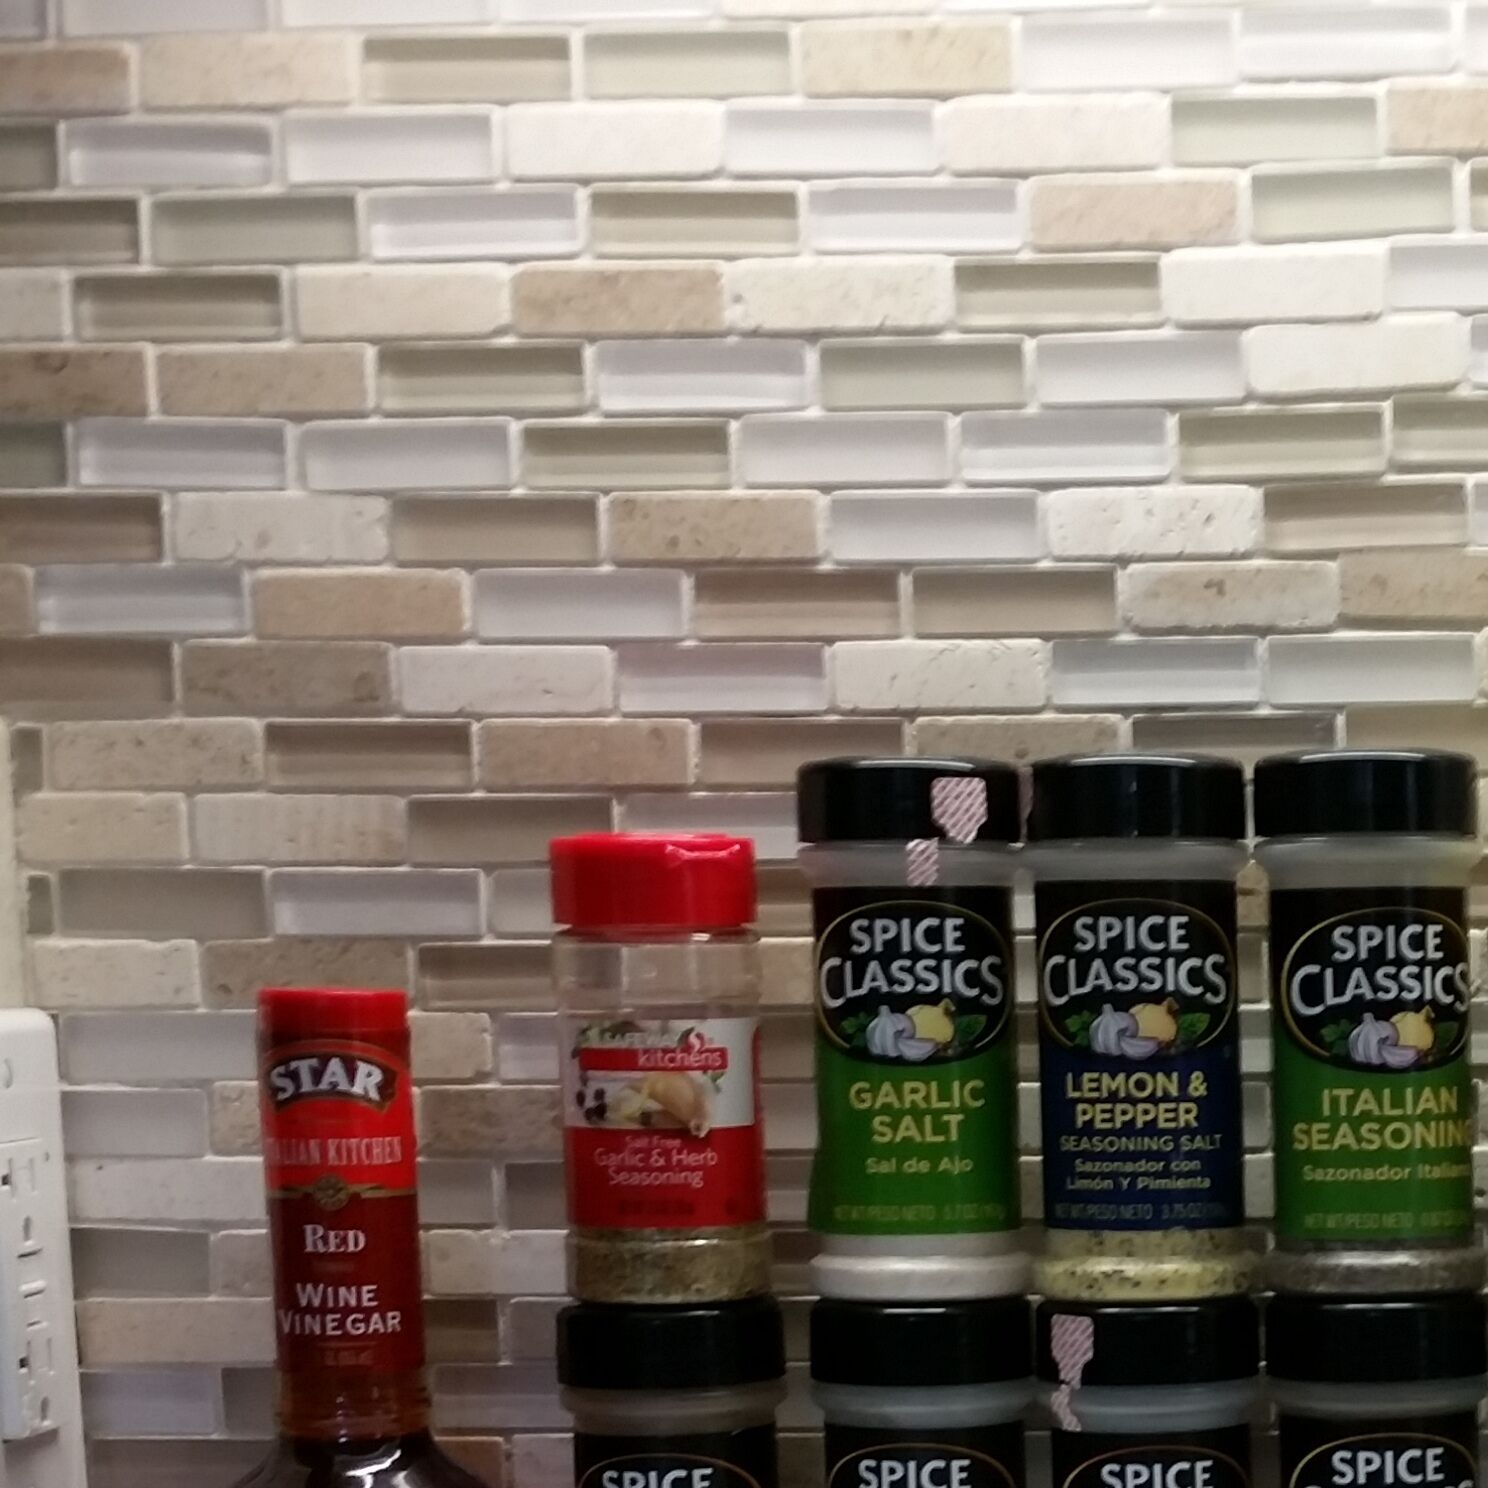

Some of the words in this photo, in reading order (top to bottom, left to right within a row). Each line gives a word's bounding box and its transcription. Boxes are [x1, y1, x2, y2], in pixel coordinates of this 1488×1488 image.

[850, 917, 966, 955] SPICE
[1073, 915, 1191, 952] SPICE
[1331, 924, 1444, 961] SPICE
[820, 955, 1004, 1009] CLASSICS
[1043, 953, 1227, 1007] CLASSICS
[1290, 962, 1469, 1016] CLASSICS
[637, 1050, 722, 1068] kitchens
[269, 1056, 384, 1101] STAR
[1065, 1071, 1180, 1099] LEMON
[1188, 1071, 1208, 1097] &
[849, 1080, 986, 1110] GARLIC
[1322, 1087, 1458, 1117] ITALIAN
[872, 1113, 965, 1144] SALT
[1075, 1102, 1198, 1129] PEPPER
[327, 1136, 402, 1166] KITCHEN
[594, 1148, 645, 1167] Garlic
[649, 1149, 666, 1167] &
[671, 1147, 718, 1167] Herb
[1059, 1135, 1175, 1152] SEASONING
[1180, 1133, 1223, 1151] SALT
[609, 1167, 704, 1188] Seasoning
[865, 1157, 897, 1174] Sal
[903, 1157, 931, 1174] de
[938, 1156, 974, 1176] Ajo
[1074, 1158, 1166, 1174] Sazonador
[1170, 1159, 1201, 1173] con
[1303, 1164, 1411, 1181] Sazonador
[295, 1282, 378, 1308] WINE
[276, 1310, 402, 1336] VINEGAR
[1331, 1447, 1445, 1485] SPICE
